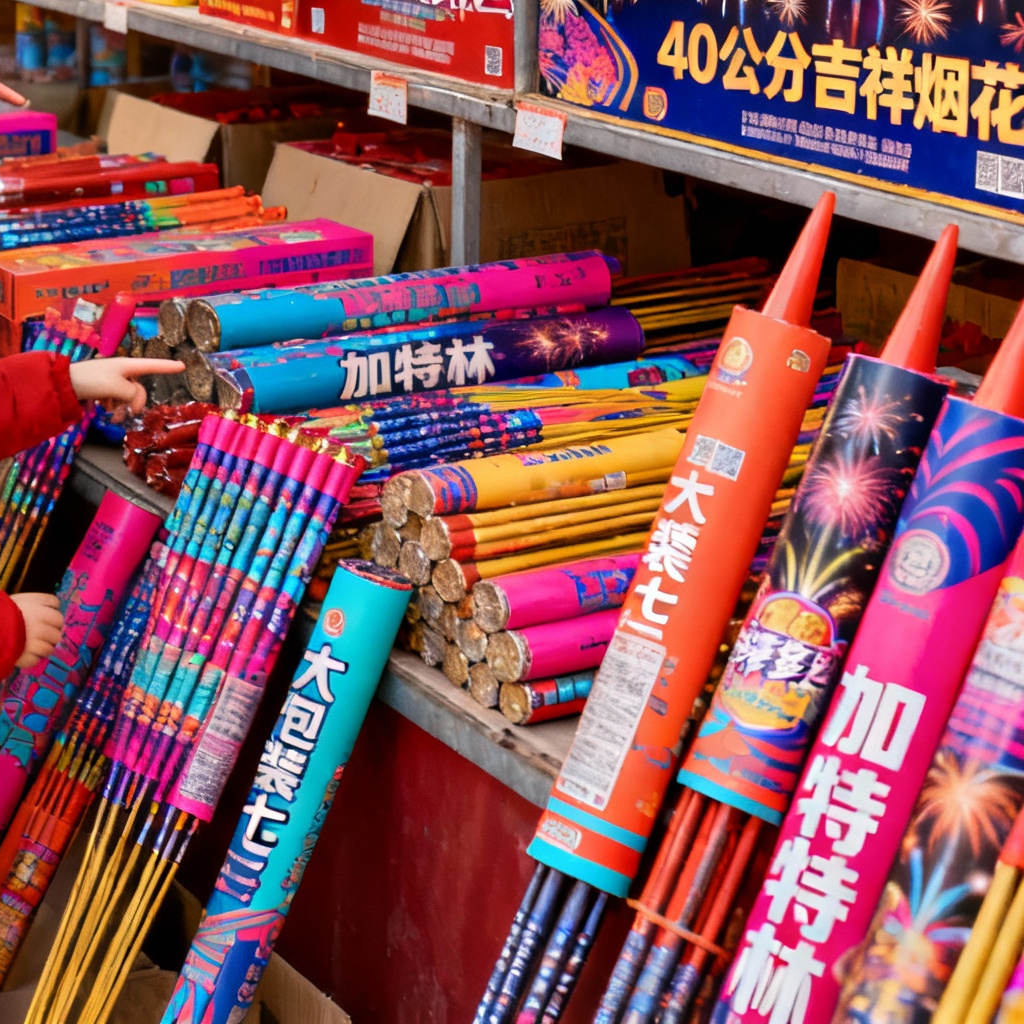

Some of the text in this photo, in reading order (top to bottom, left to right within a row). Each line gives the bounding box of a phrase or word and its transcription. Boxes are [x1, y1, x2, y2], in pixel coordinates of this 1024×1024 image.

[657, 20, 1024, 146] 40公分吉祥烟花
[340, 335, 495, 401] 加特林
[727, 664, 927, 1024] 加特特林
